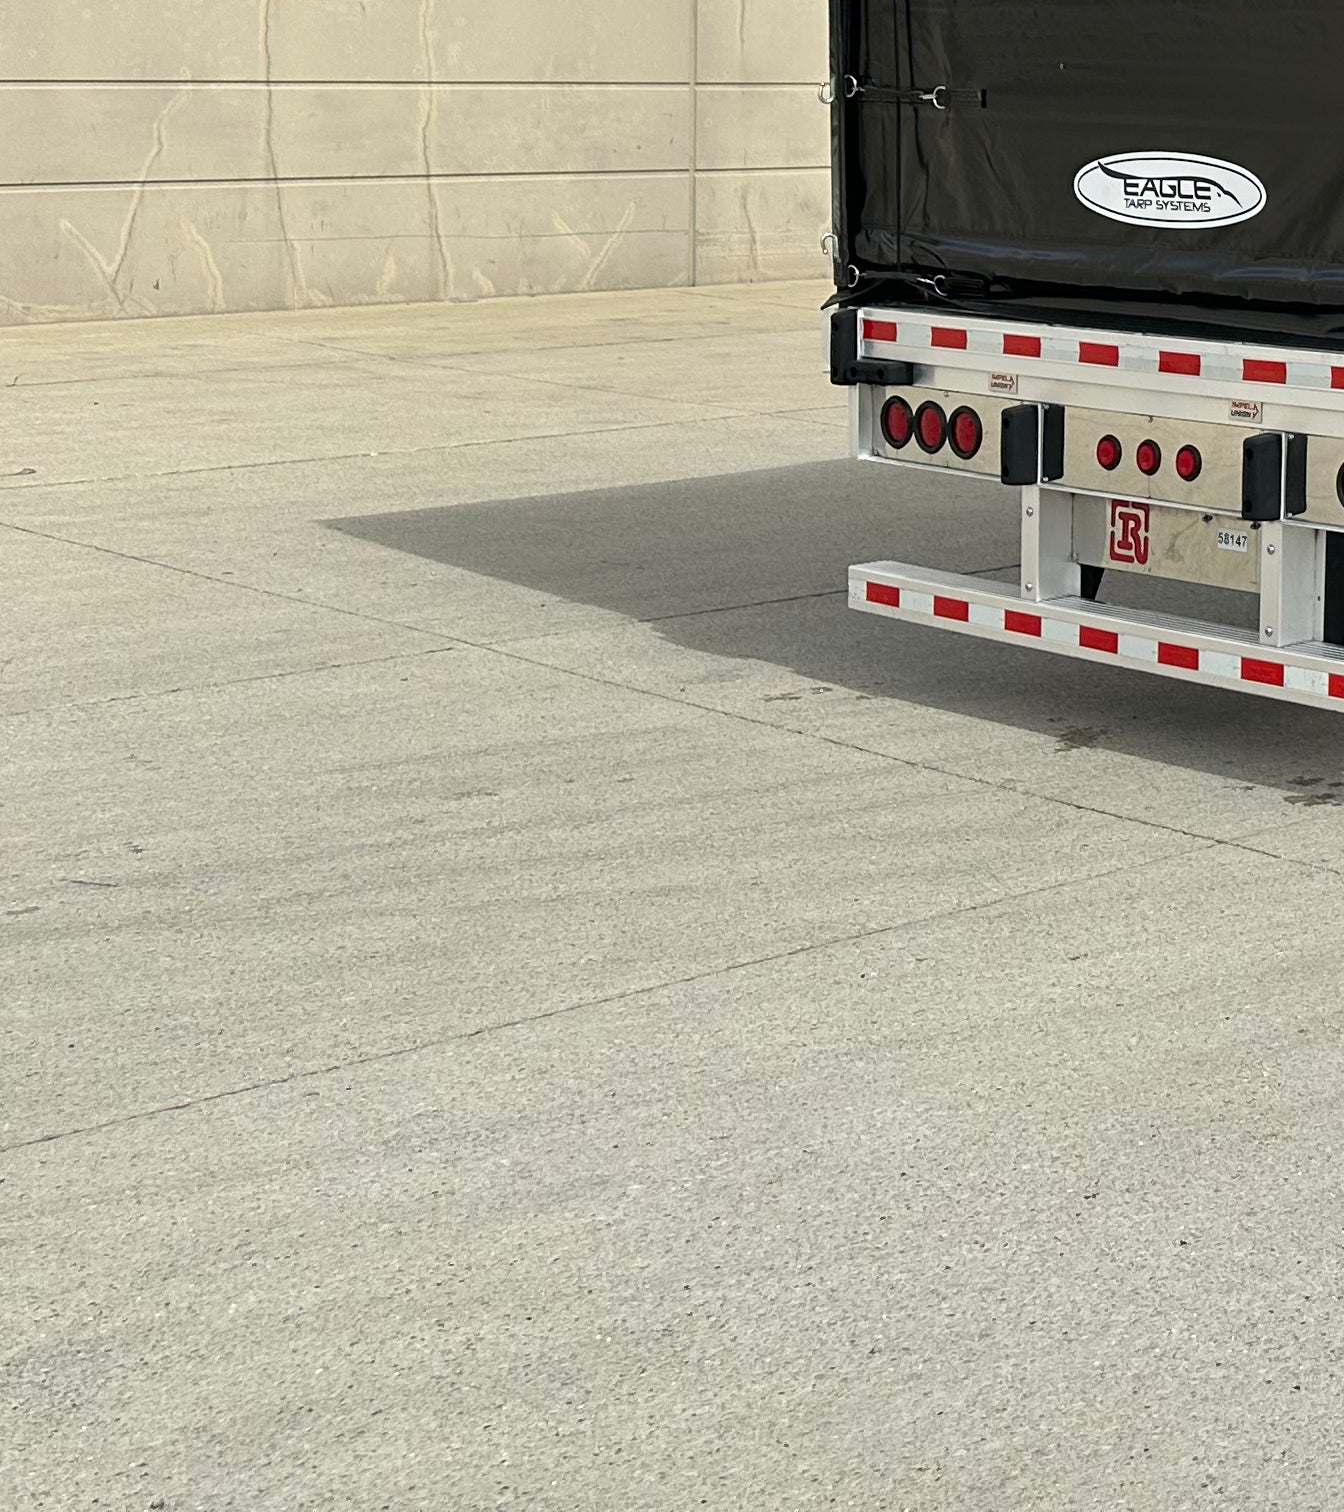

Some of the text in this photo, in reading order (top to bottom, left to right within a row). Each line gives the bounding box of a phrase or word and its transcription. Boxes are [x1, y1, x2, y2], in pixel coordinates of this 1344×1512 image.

[1123, 177, 1212, 200] EAGLE
[1124, 198, 1211, 212] TARP SYSTEMS
[1217, 531, 1248, 548] 58147
